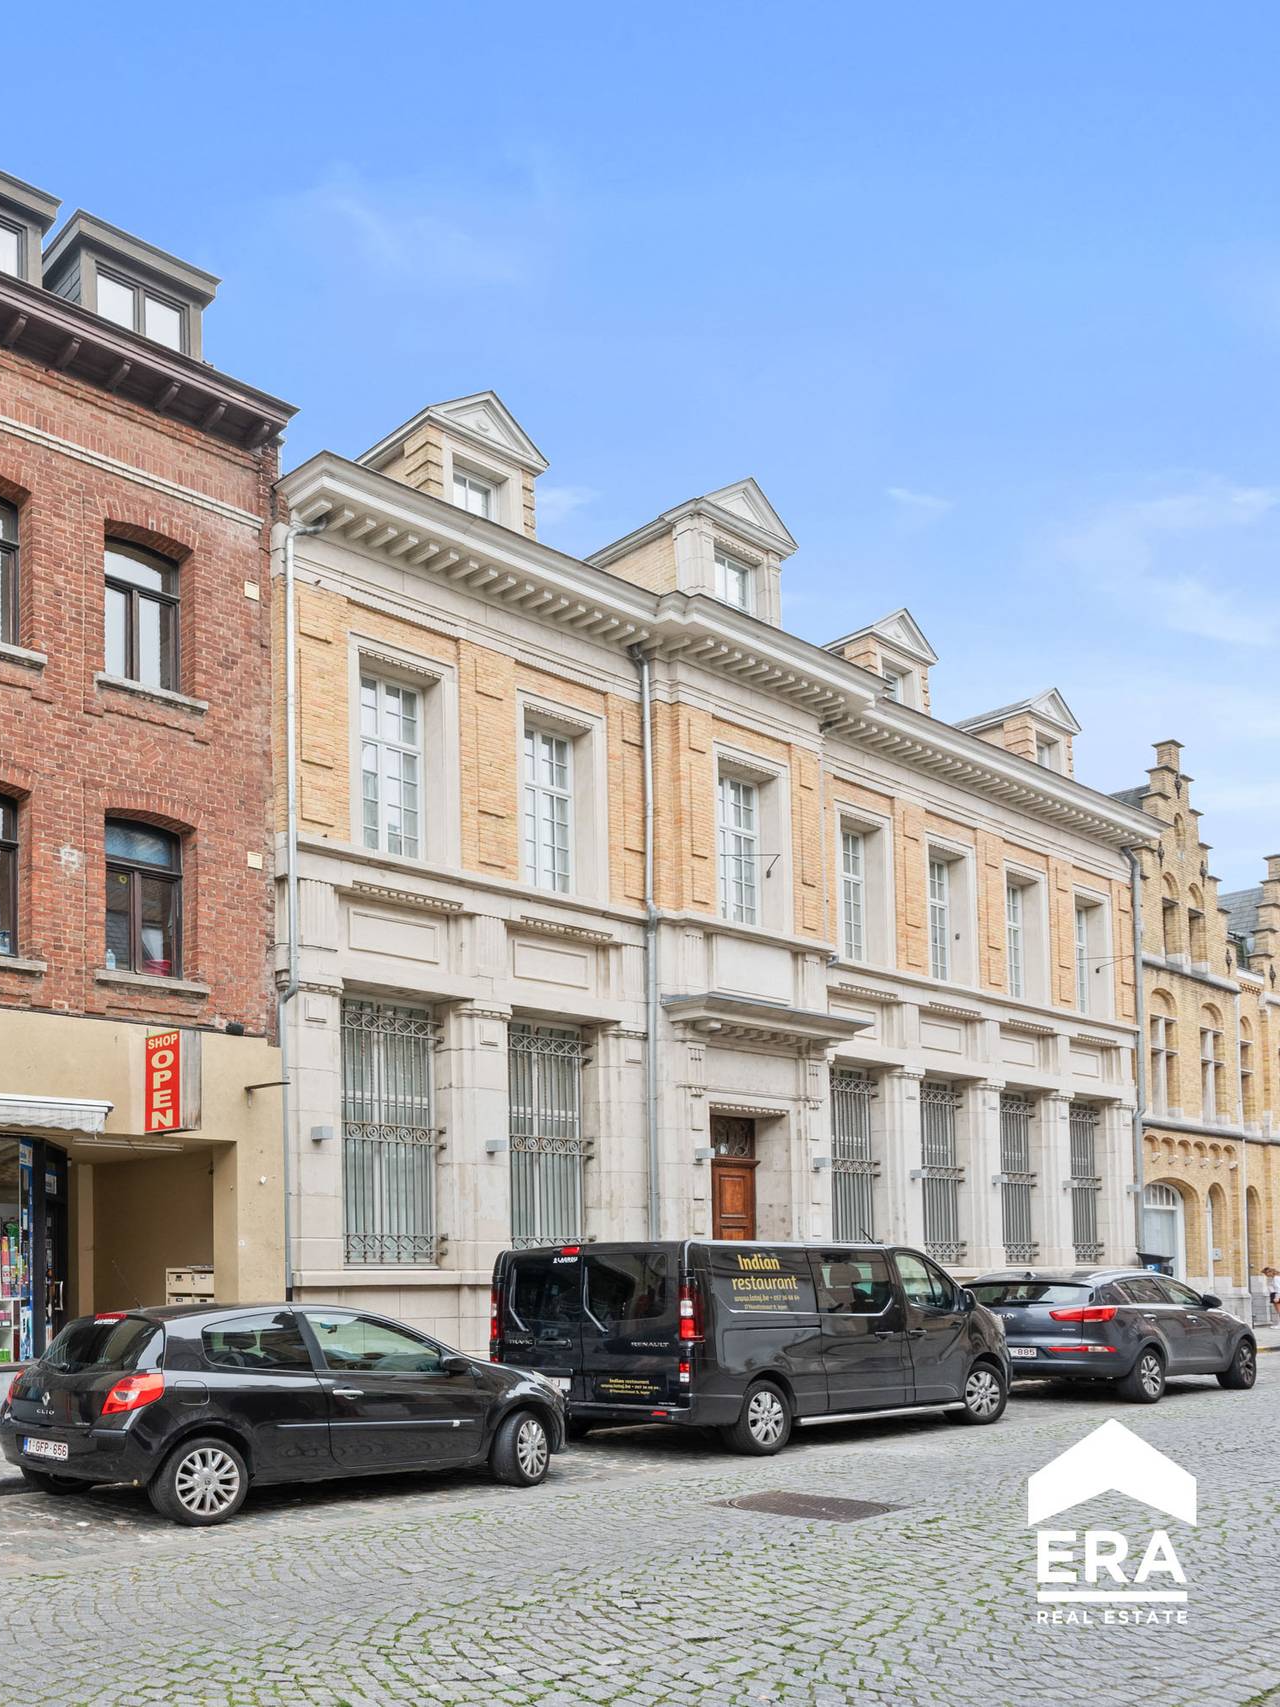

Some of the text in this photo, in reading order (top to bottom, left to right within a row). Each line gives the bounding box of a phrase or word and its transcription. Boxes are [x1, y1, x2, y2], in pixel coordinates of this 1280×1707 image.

[148, 1033, 178, 1049] SHOP
[151, 1049, 175, 1129] OPEN
[737, 1253, 781, 1271] Indian
[731, 1275, 799, 1290] restaurant
